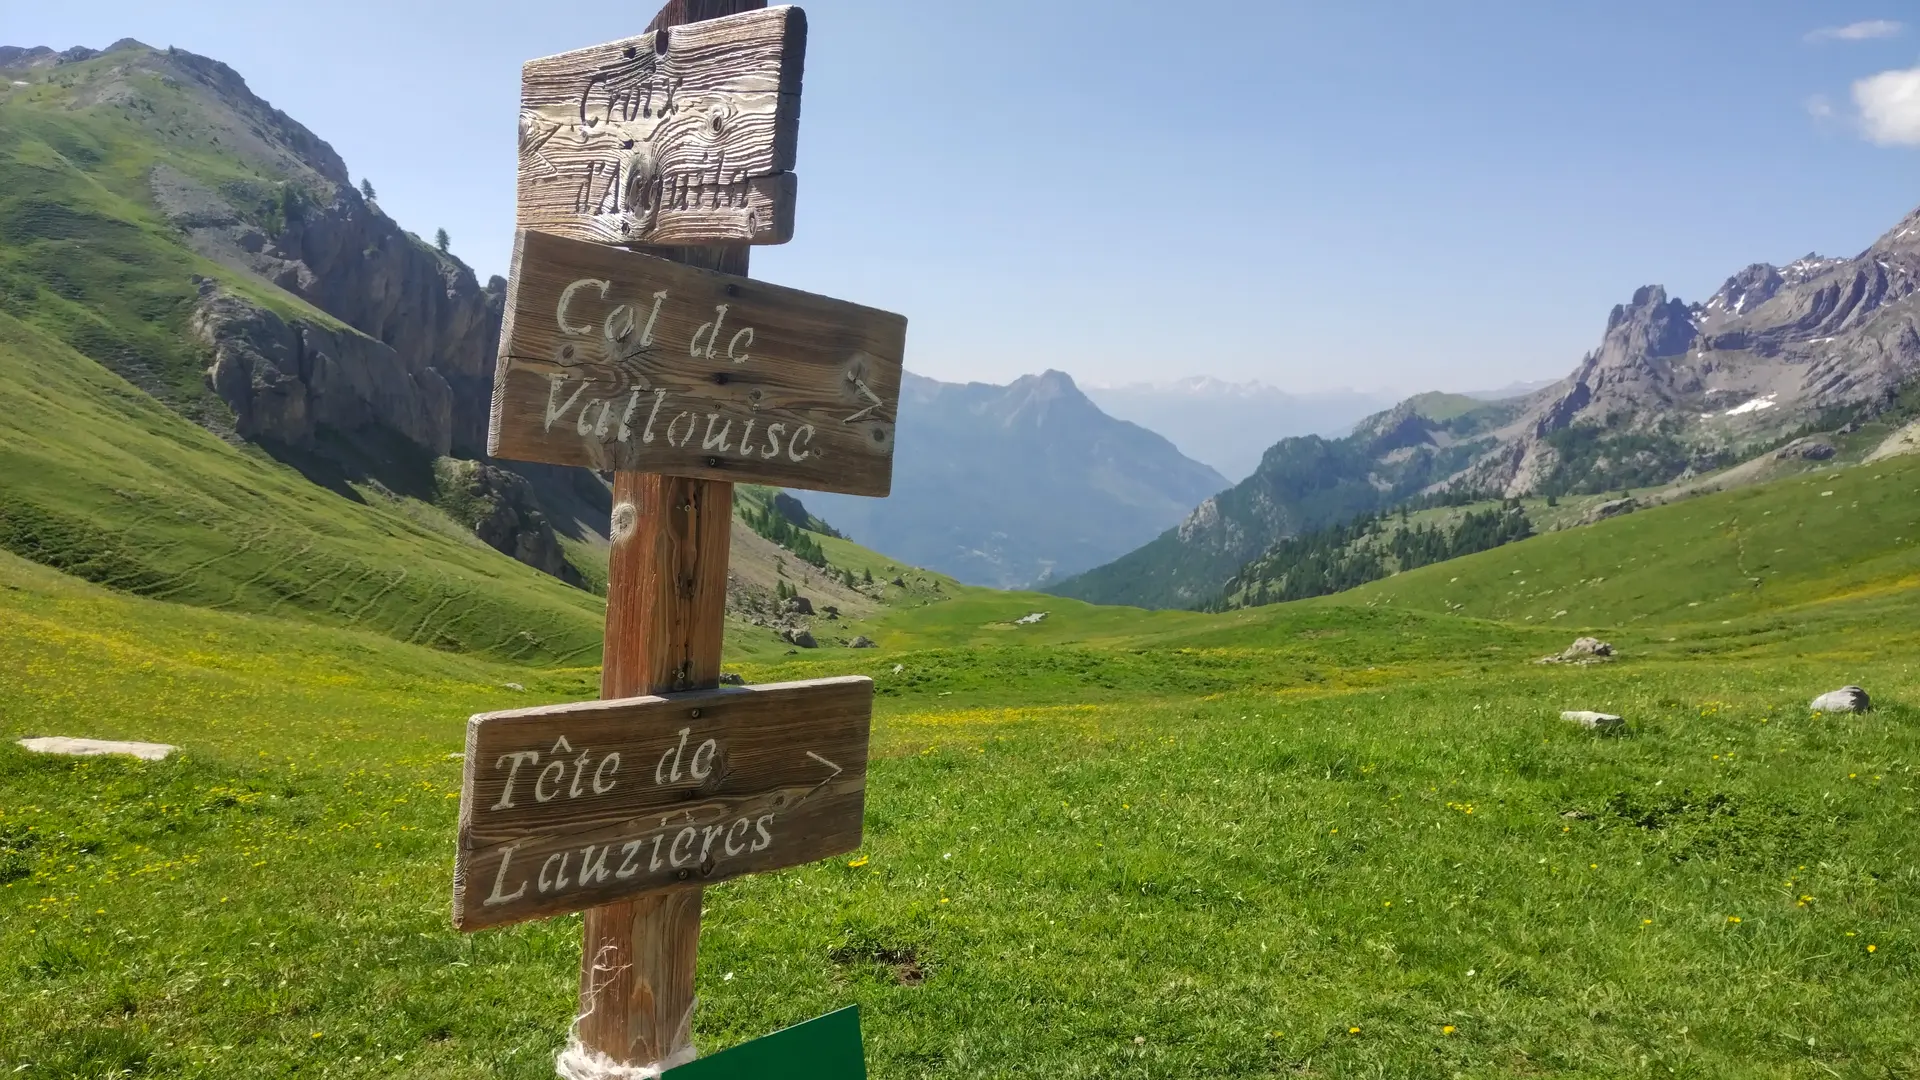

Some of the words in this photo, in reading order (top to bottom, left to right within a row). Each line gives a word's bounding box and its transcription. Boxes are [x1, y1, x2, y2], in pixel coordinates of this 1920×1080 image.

[579, 73, 683, 125] Croix
[556, 278, 668, 348] Col
[690, 303, 754, 364] de
[544, 373, 816, 463] Vallouise
[491, 734, 620, 811] Tête
[655, 727, 717, 785] de
[483, 809, 775, 906] Lauzières
